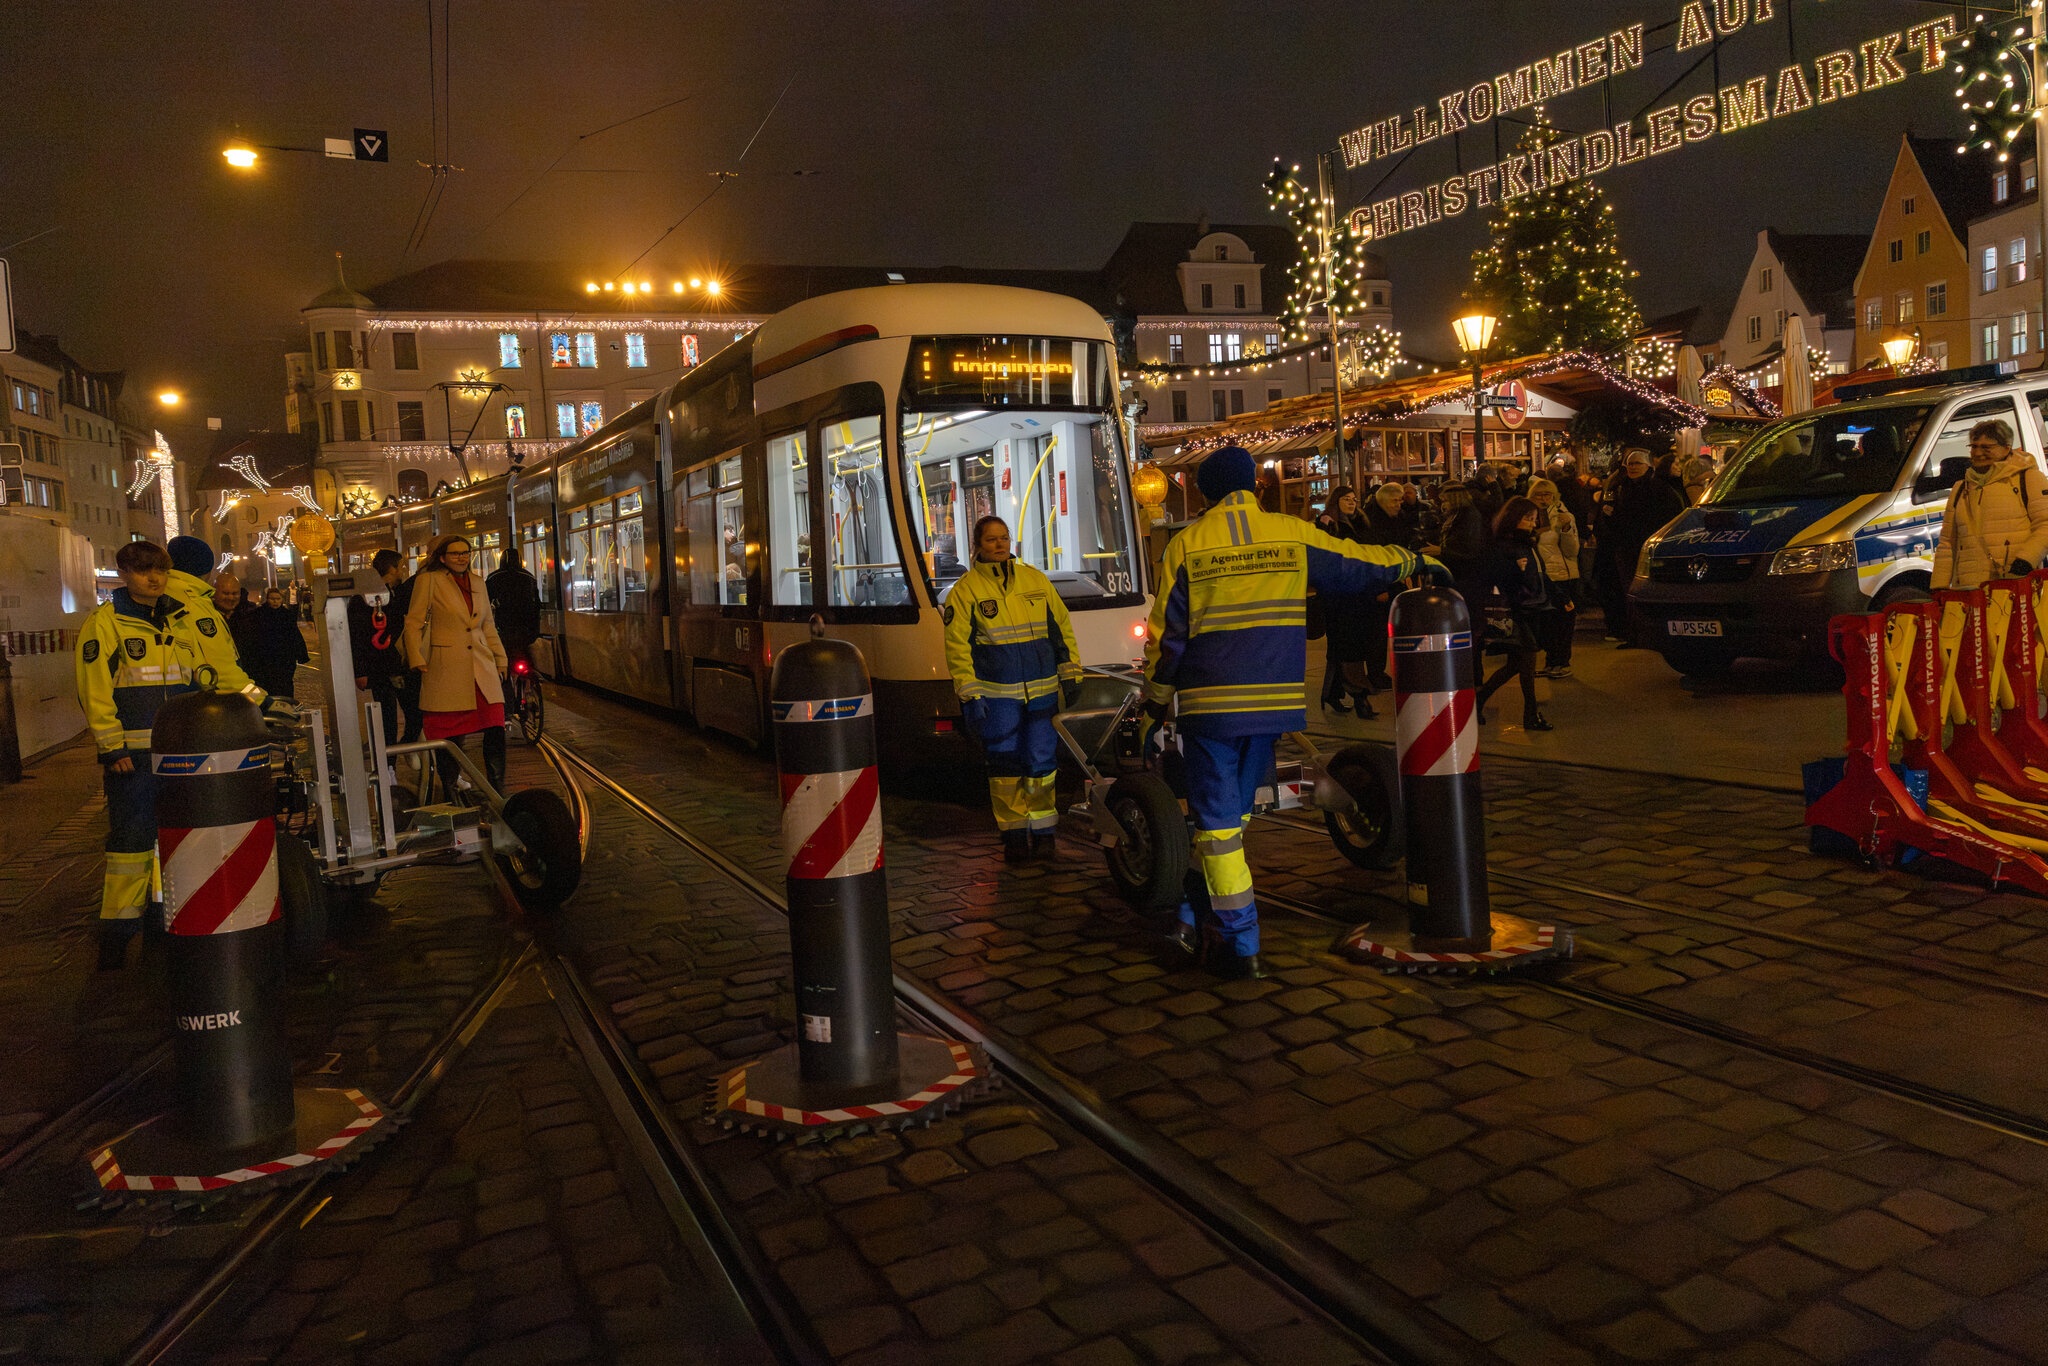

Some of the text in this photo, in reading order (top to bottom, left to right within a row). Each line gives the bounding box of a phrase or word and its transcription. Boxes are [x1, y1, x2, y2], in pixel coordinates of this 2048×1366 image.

[1339, 23, 1643, 169] WILLKOMMEN
[1349, 14, 1956, 244] CHRISTKINDLESMARKT
[1211, 549, 1280, 565] Agentur EMV
[1677, 529, 1751, 545] POLIZEI
[1107, 571, 1132, 593] 873
[1672, 622, 1717, 635] A PS 545
[1924, 618, 1934, 694] PITAGONE
[1973, 606, 1984, 680] PITAGONE
[2019, 593, 2030, 665] PITAGONE
[1869, 631, 1882, 709] PITAGONE
